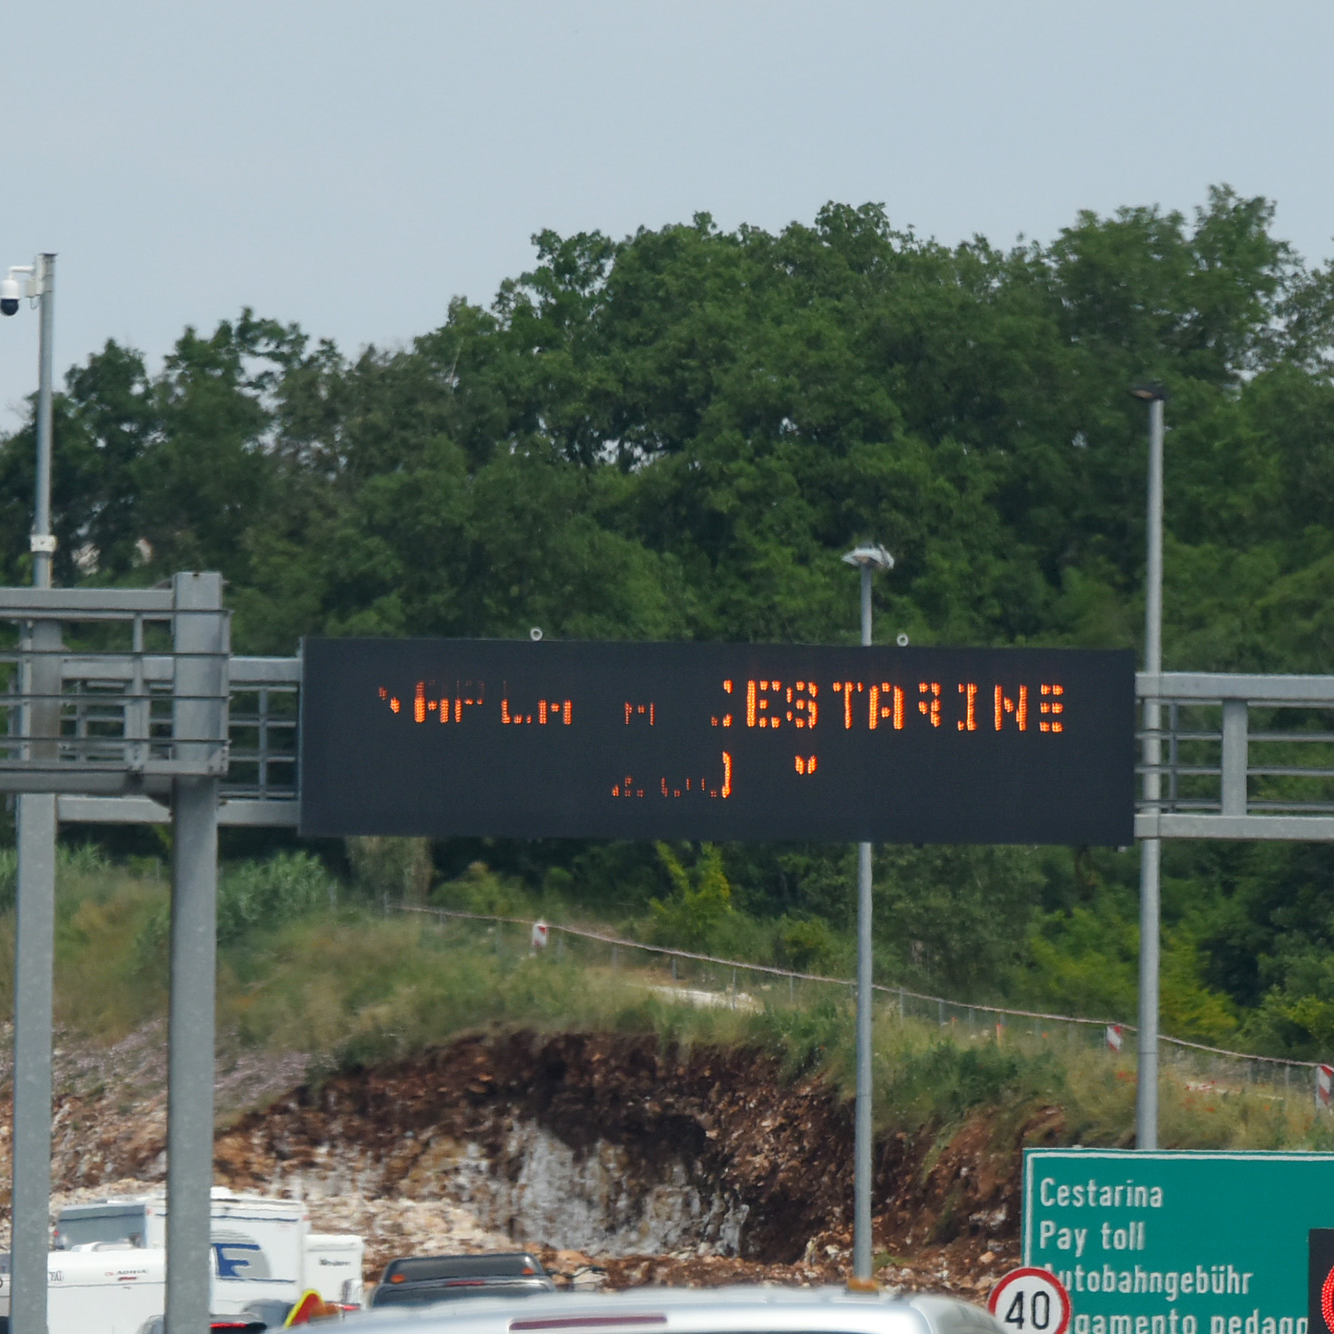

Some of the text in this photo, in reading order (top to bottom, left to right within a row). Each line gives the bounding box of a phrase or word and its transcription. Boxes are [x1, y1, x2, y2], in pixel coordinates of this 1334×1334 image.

[1040, 1177, 1163, 1207] Cestarina
[1040, 1220, 1146, 1257] Pay toll
[1044, 1263, 1254, 1301] utobahngebühr
[1005, 1290, 1051, 1330] 40
